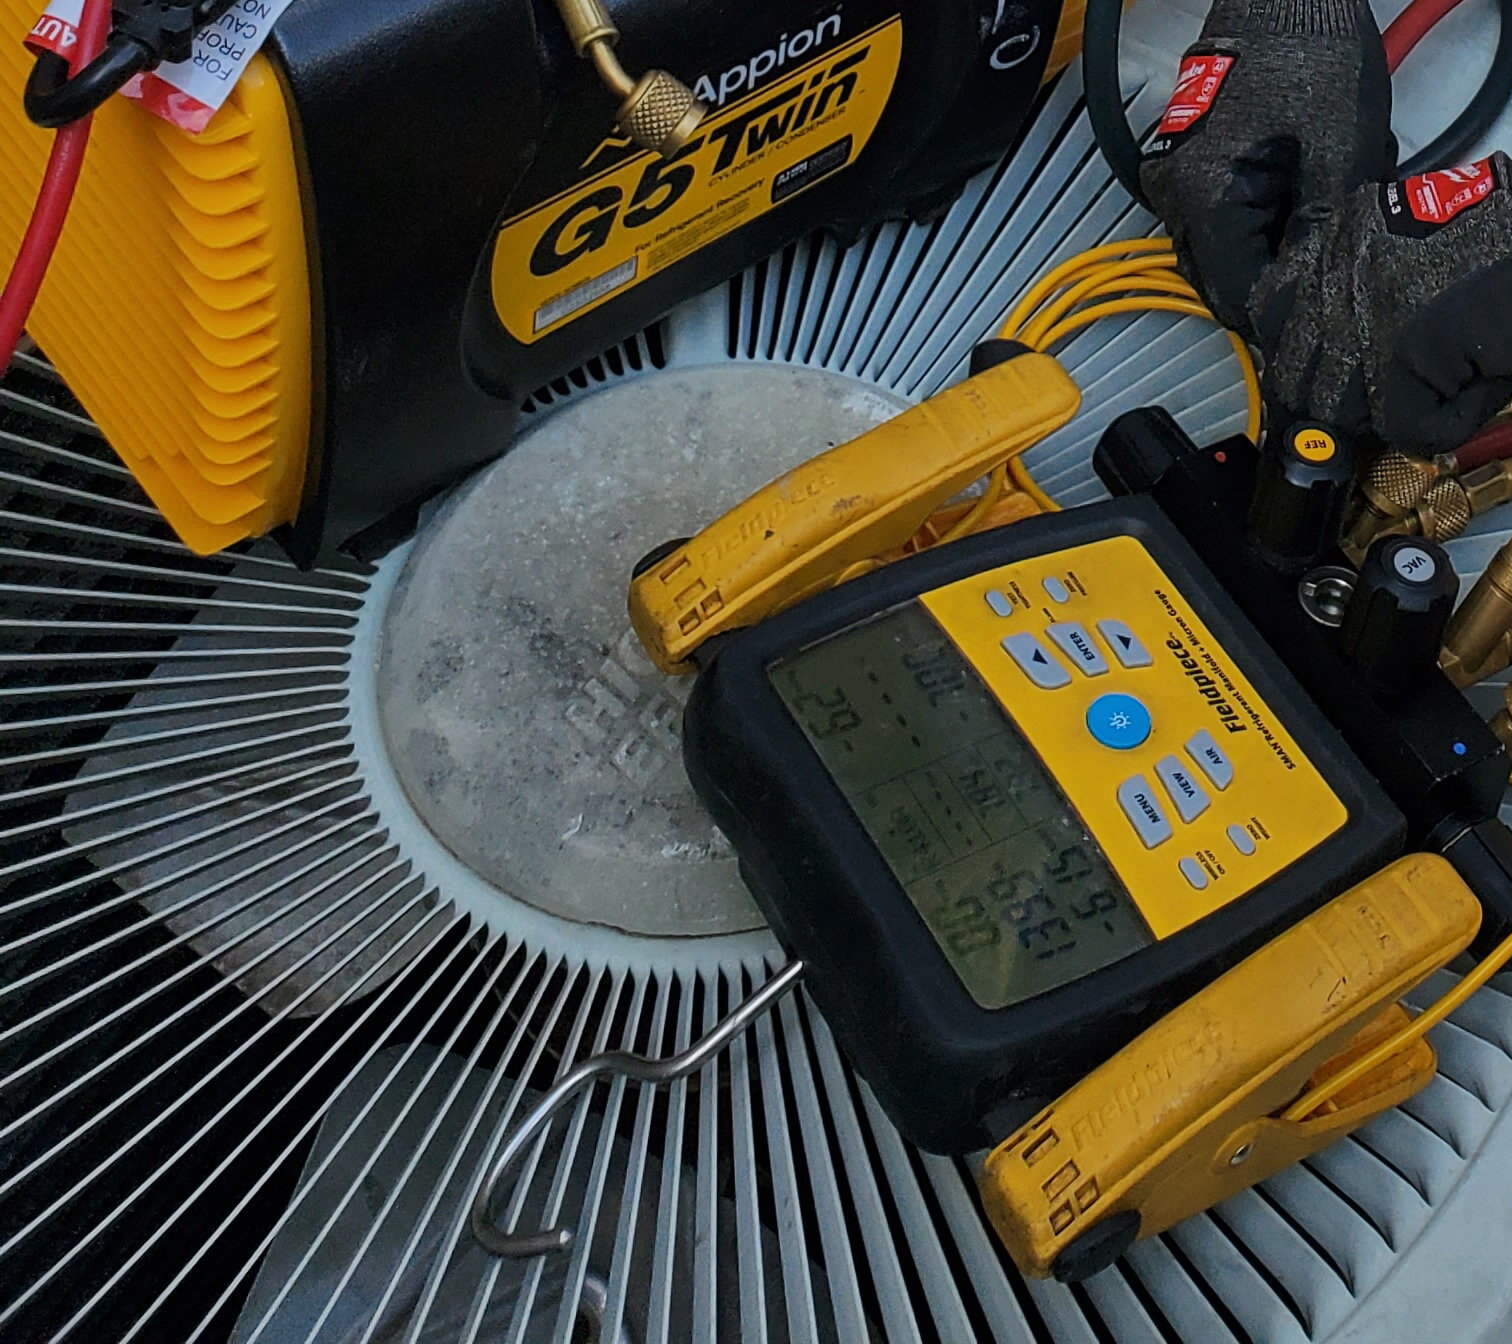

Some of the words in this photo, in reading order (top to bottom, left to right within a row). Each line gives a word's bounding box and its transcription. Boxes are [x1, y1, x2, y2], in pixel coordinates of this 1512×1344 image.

[191, 49, 233, 81] FOR
[692, 14, 842, 106] Appion
[529, 136, 707, 277] G5
[708, 44, 872, 176] Twin
[1304, 438, 1326, 449] REF
[1401, 555, 1425, 574] VAC
[1152, 588, 1177, 617] Gauge
[1068, 631, 1095, 659] ENTER
[1173, 616, 1200, 646] Micron
[1163, 633, 1247, 734] Fieldpiece
[1201, 653, 1235, 692] Manifold
[1231, 690, 1274, 742] Refrigerant
[1204, 746, 1223, 767] AIR
[1270, 741, 1296, 771] SMAN
[1172, 769, 1196, 798] VIEW
[1133, 791, 1161, 825] MENU
[1194, 849, 1219, 881] WIRELESS
